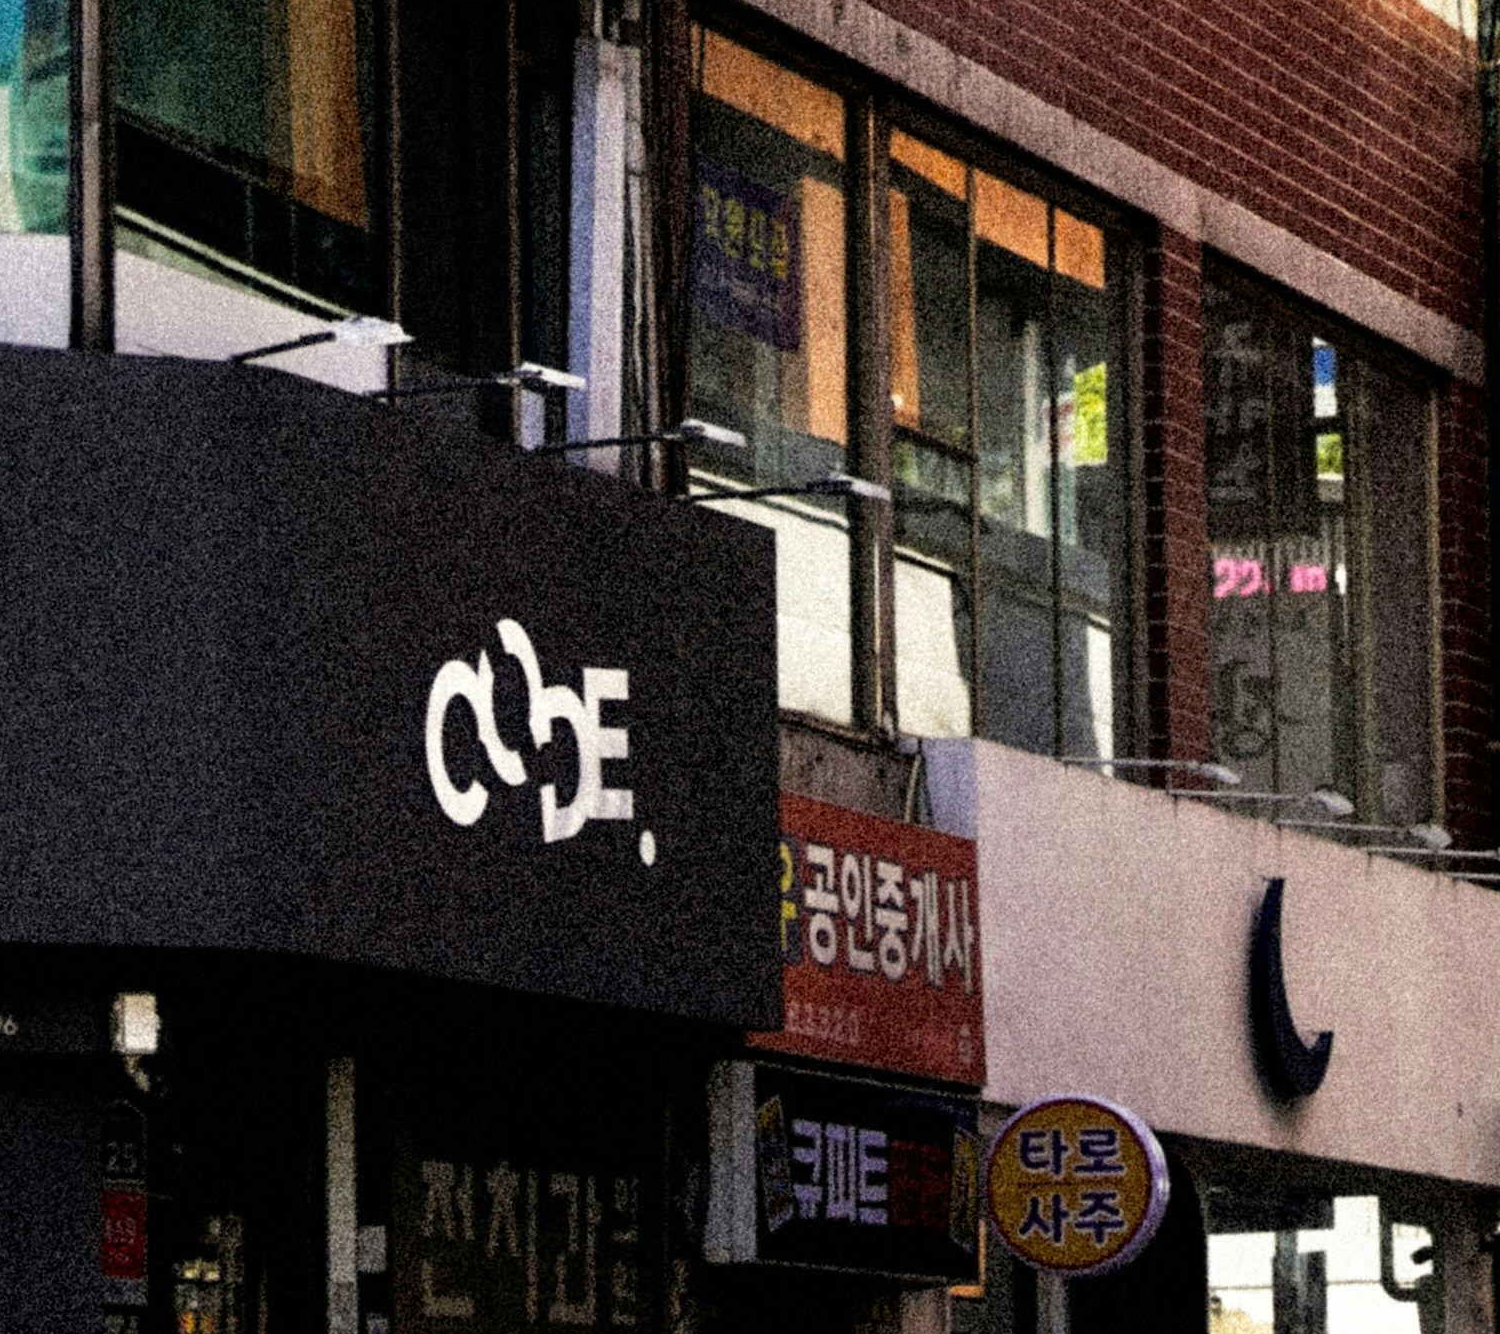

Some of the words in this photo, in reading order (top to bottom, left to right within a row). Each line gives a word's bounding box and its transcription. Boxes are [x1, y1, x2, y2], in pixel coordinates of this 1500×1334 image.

[805, 842, 974, 997] 공인중개사
[1018, 1128, 1126, 1178] 타로
[1018, 1192, 1126, 1246] 사주
